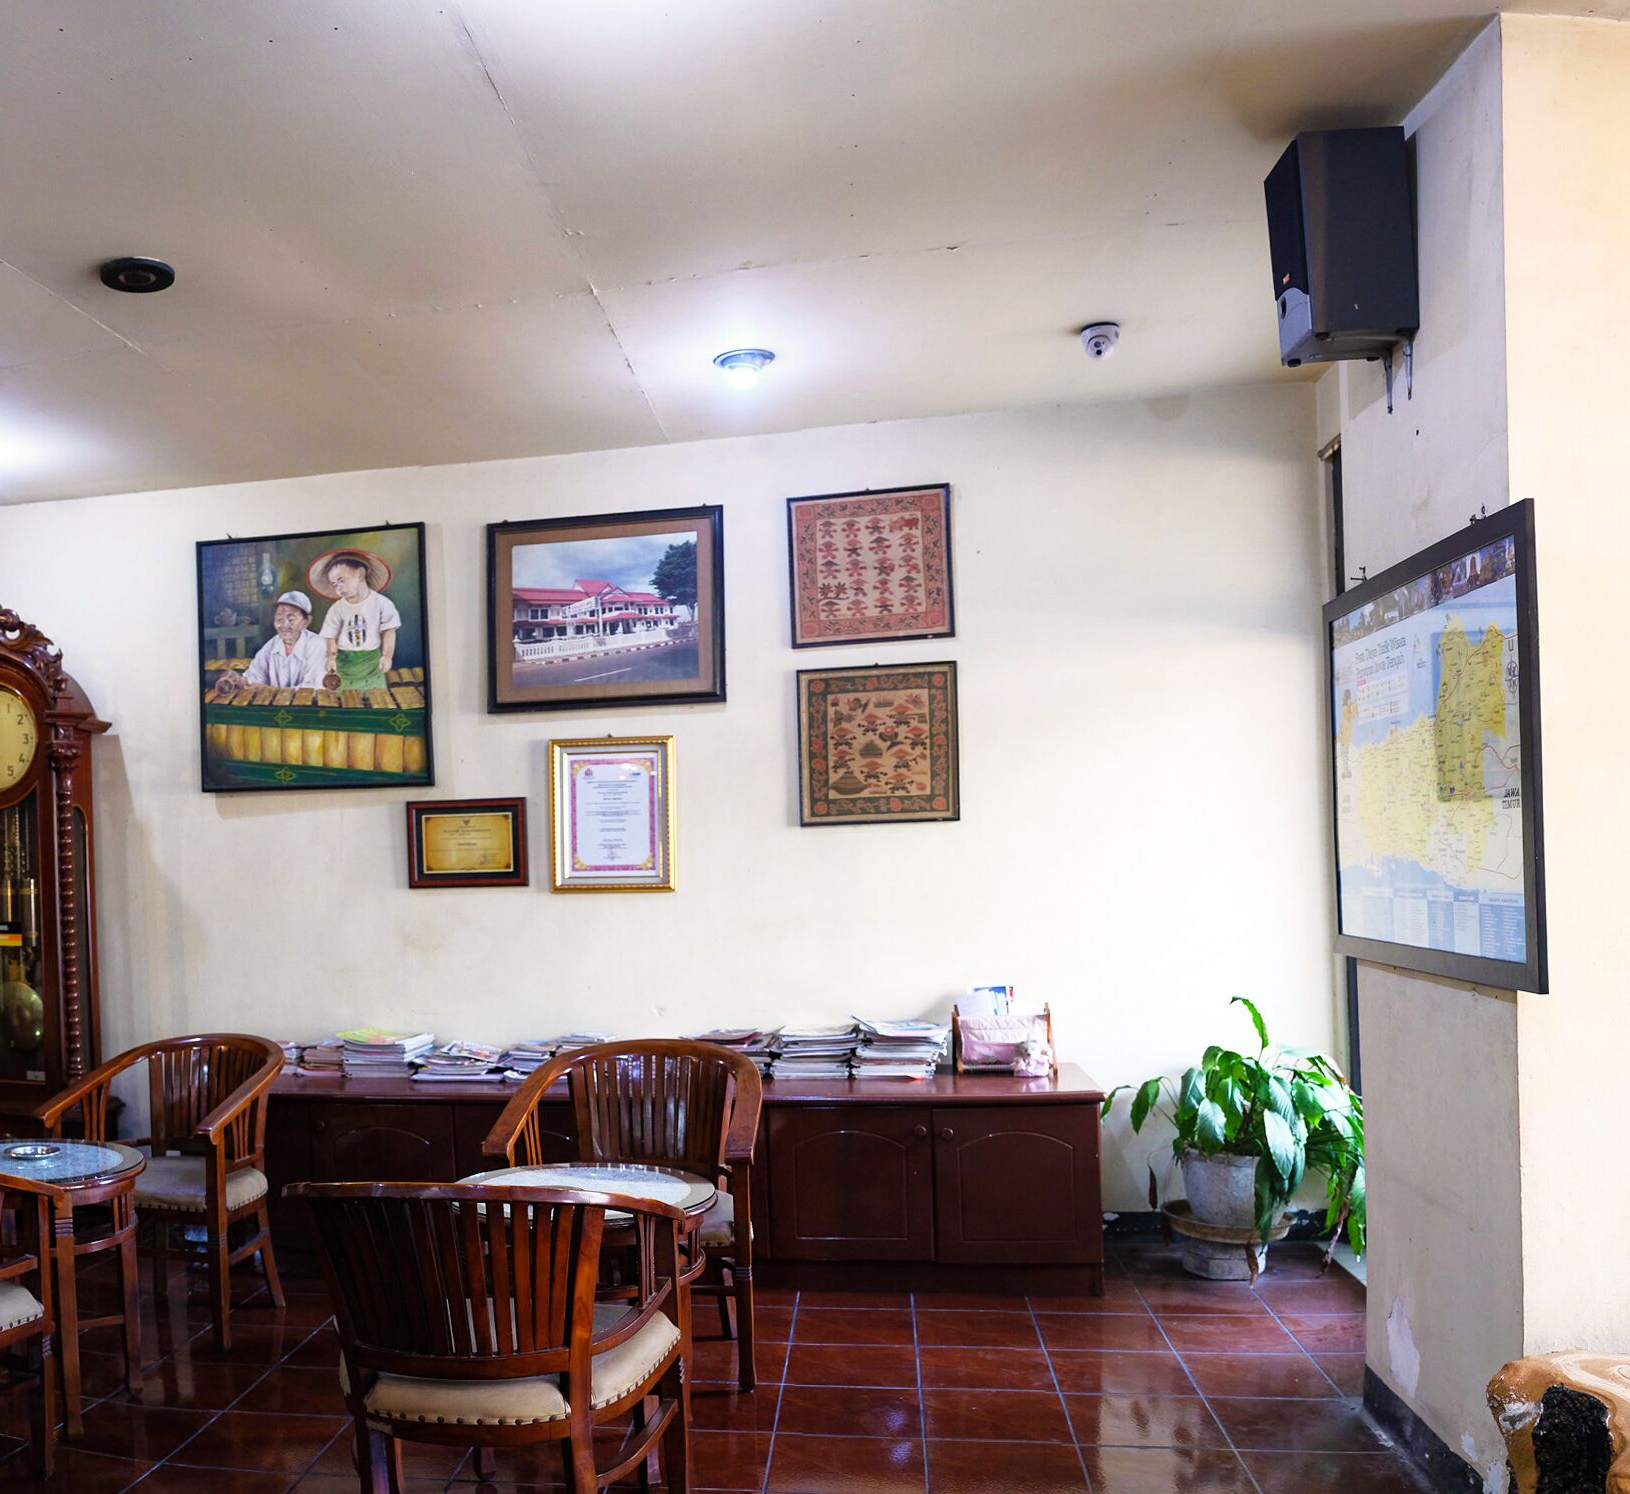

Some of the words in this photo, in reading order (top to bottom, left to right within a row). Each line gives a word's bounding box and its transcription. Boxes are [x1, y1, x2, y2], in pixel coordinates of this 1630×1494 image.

[1507, 638, 1514, 652] U
[17, 714, 24, 725] 2
[22, 733, 29, 744] 3
[19, 753, 25, 763] 4
[7, 765, 14, 776] 5
[1503, 787, 1520, 798] JAWA
